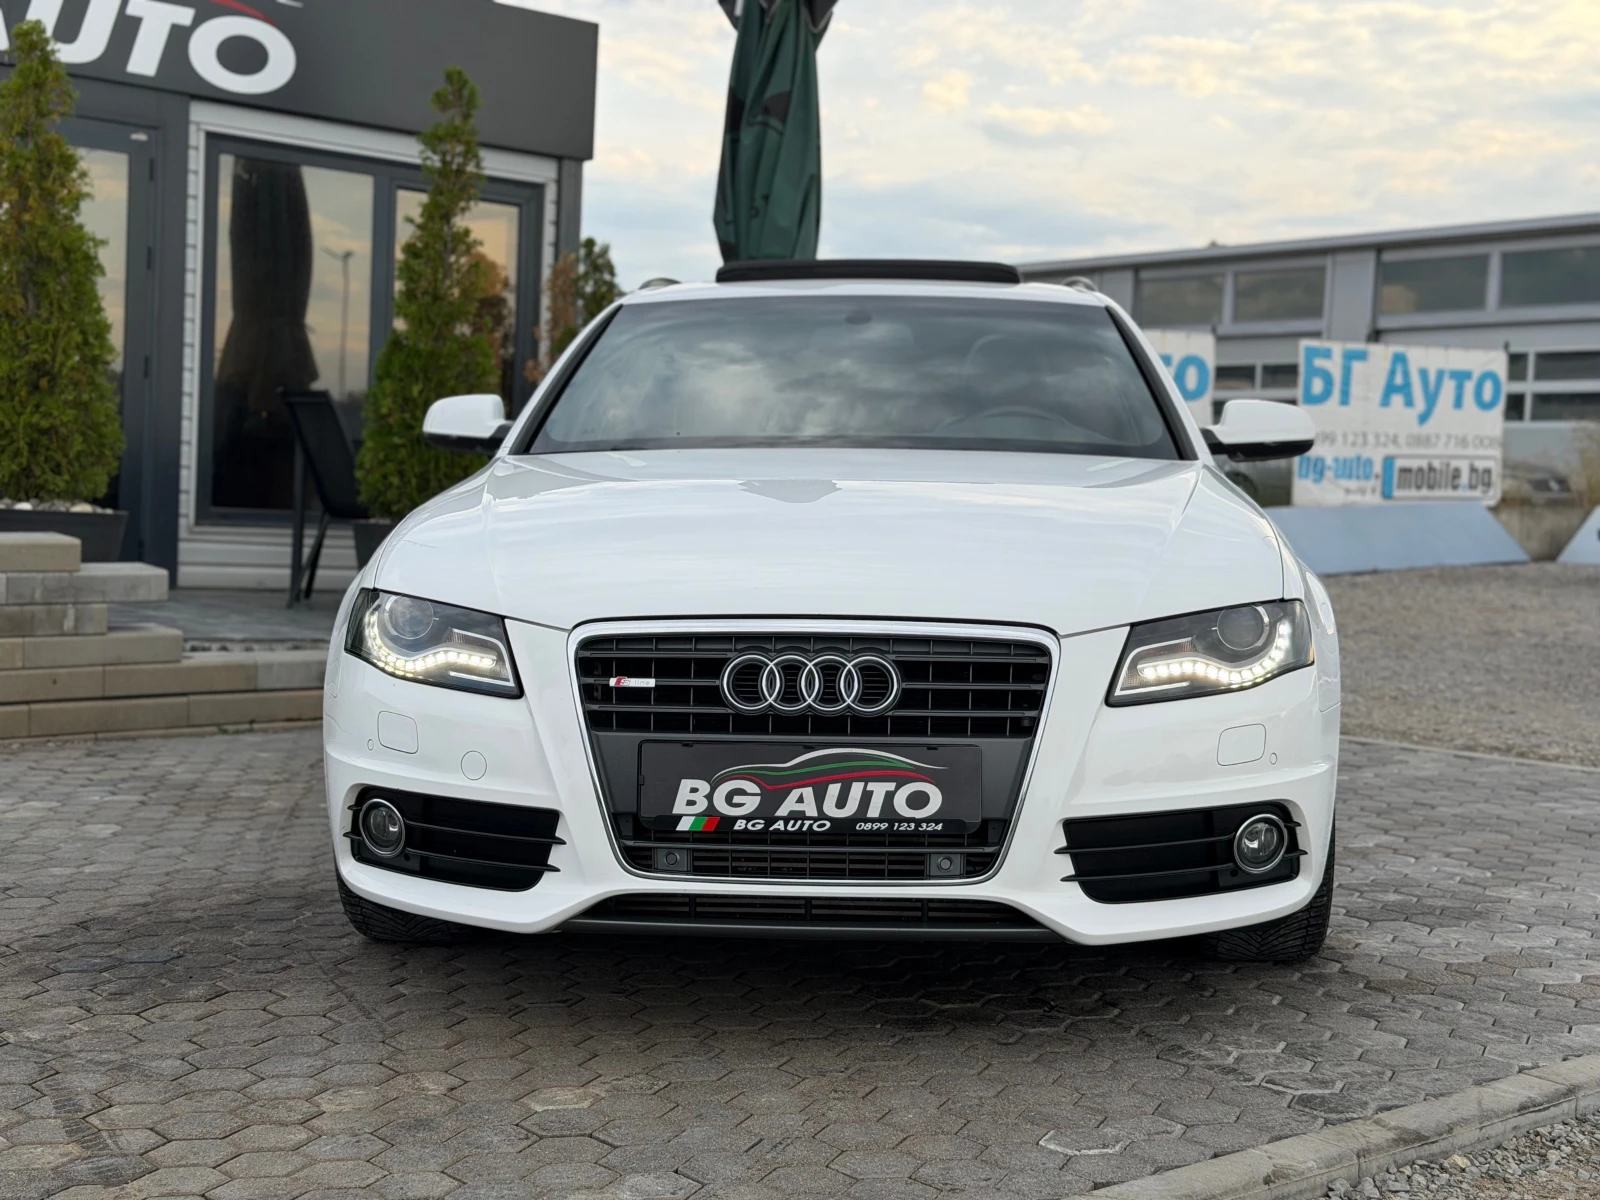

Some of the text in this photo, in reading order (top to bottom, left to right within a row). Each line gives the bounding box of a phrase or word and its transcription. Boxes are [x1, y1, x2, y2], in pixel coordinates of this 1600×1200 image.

[0, 0, 297, 95] UTO
[1302, 346, 1503, 427] БГ Ауто
[672, 778, 943, 819] BG AUTO
[733, 819, 943, 832] BG AUTO 0899 123 324
